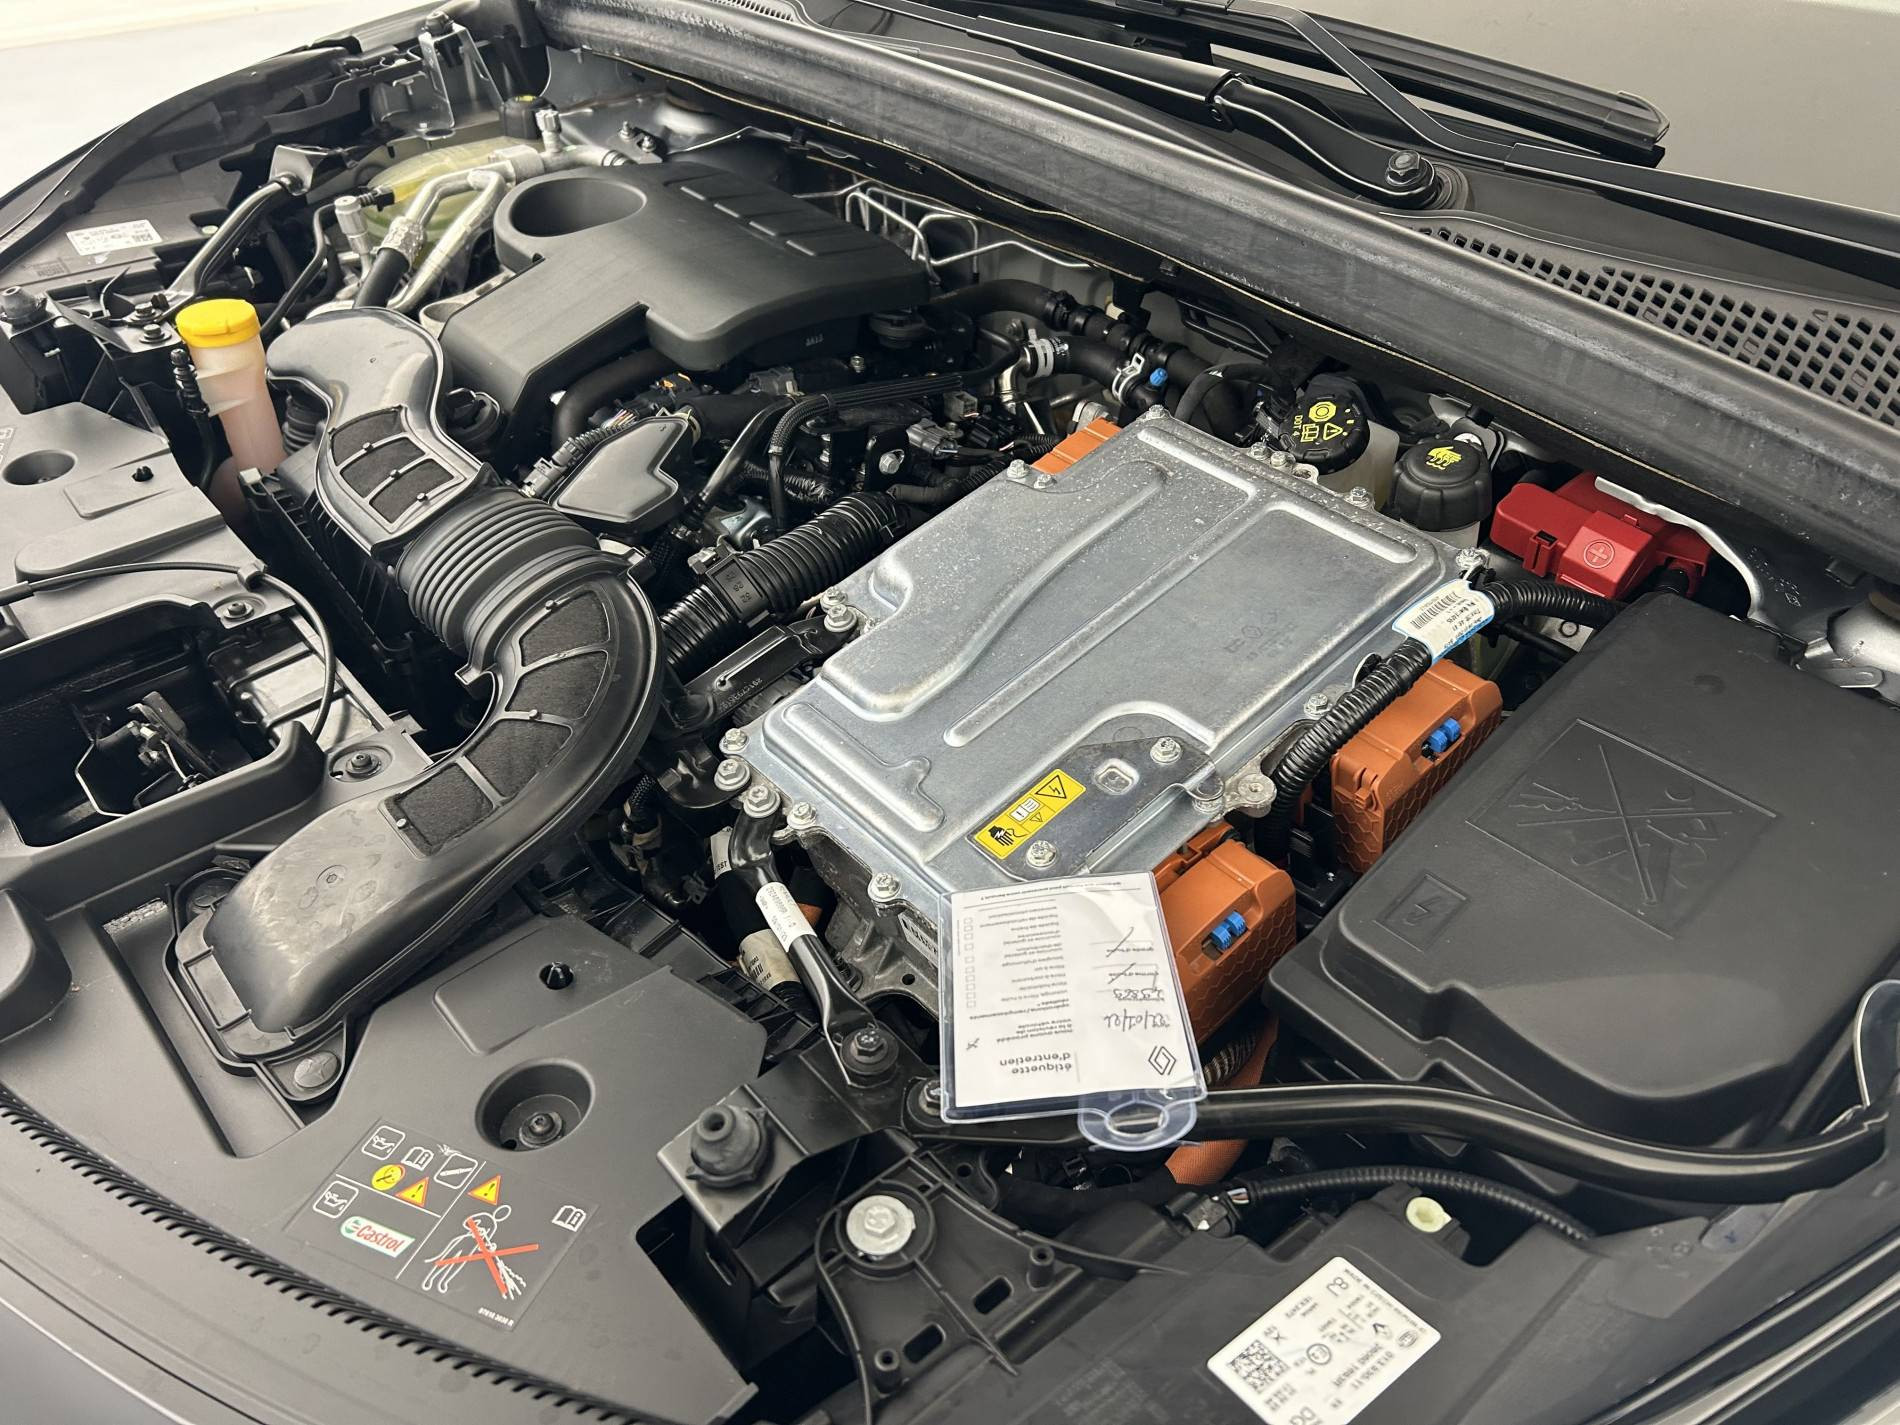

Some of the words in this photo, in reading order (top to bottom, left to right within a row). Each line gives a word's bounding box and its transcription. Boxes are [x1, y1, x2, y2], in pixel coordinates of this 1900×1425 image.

[1000, 1052, 1071, 1066] d'entretien
[1011, 1063, 1072, 1074] étiquette
[356, 1225, 405, 1252] Castrol
